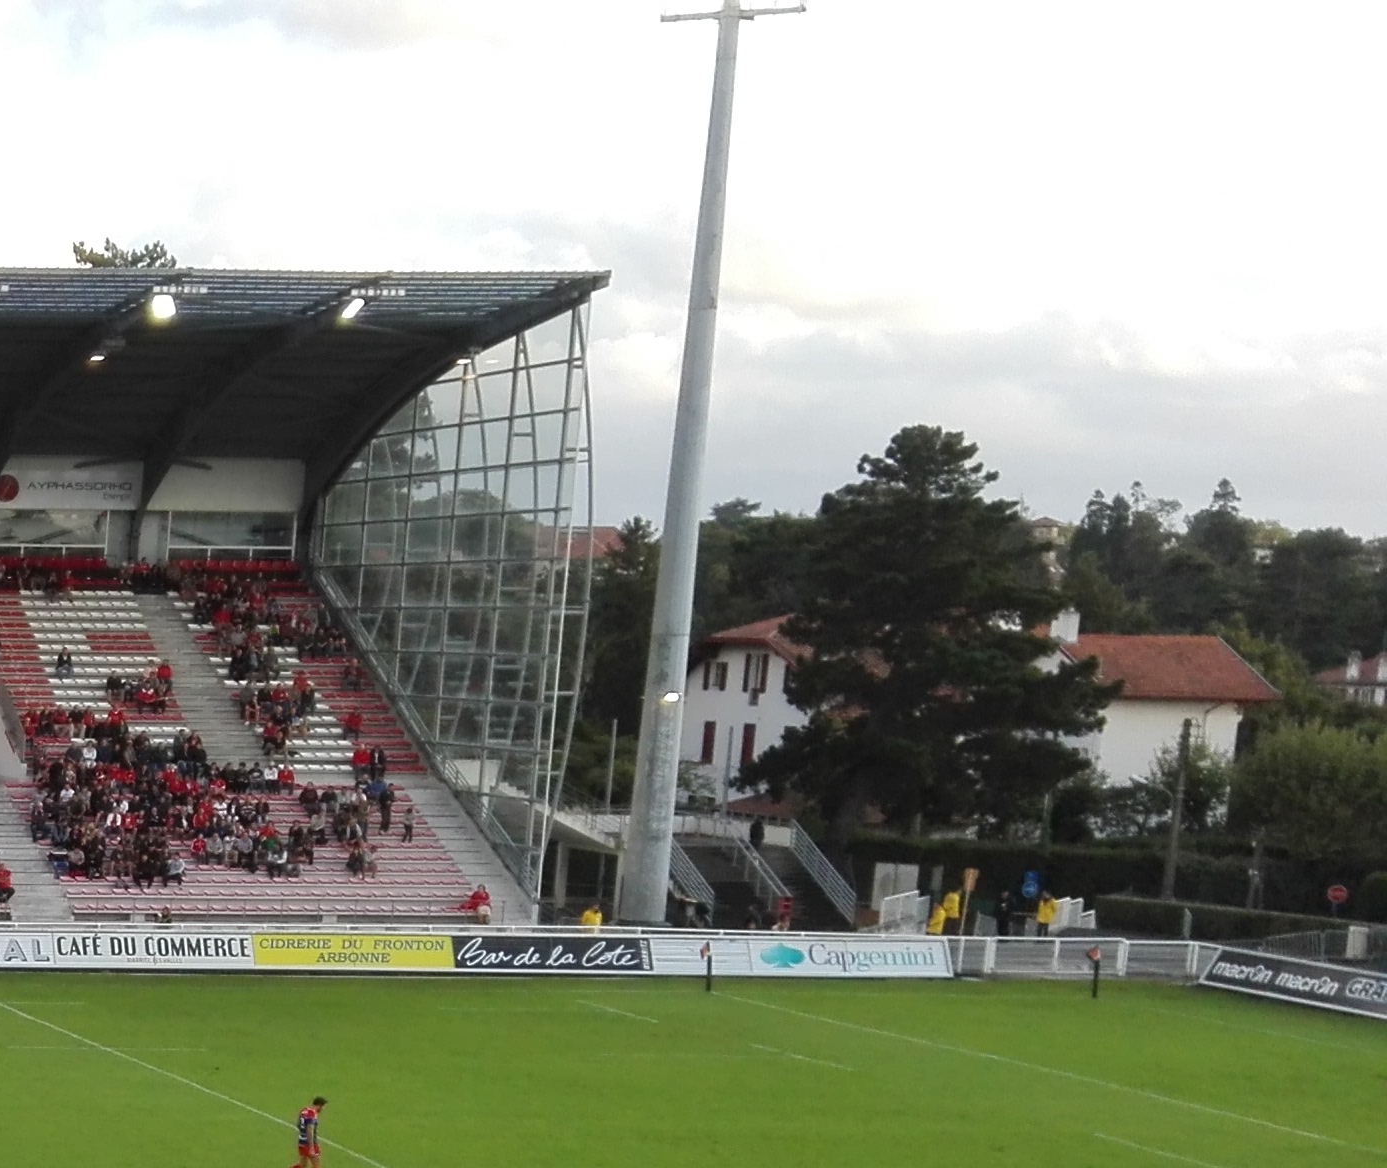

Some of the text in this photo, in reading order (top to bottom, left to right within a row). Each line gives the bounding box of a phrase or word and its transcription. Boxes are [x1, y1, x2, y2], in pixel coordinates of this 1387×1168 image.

[57, 934, 251, 958] CAFÉ DU COMMERCE
[259, 938, 444, 951] CIDRERIE DU FRONTON
[457, 937, 512, 966] Bar
[514, 946, 541, 966] de
[545, 945, 576, 966] la
[317, 952, 391, 964] ARBONNE
[808, 943, 936, 972] Capgemini
